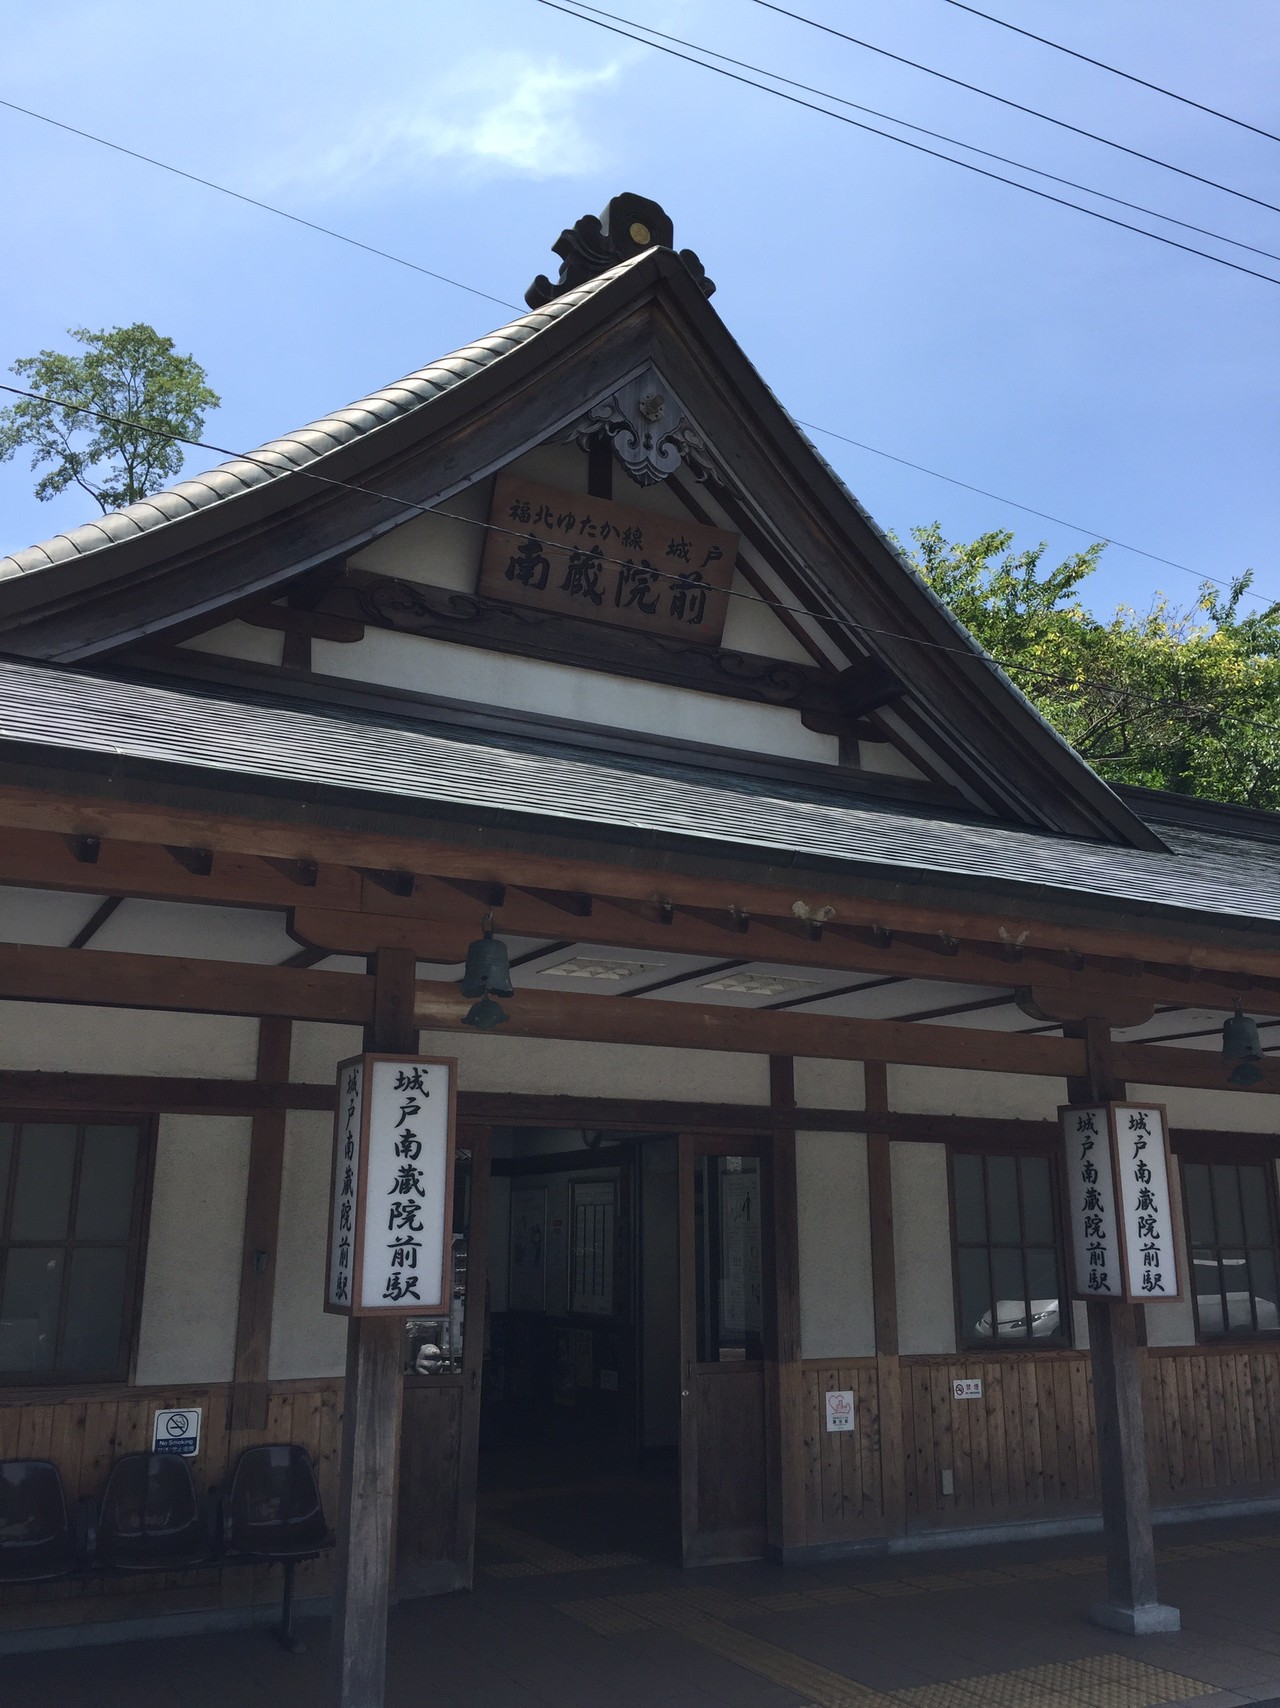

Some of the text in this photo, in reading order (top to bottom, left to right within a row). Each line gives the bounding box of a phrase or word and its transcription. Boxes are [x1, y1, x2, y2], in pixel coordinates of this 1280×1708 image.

[504, 532, 713, 624] 南蔵院前
[508, 499, 724, 568] 福北ゆたか線 城戸
[335, 1068, 359, 1301] 城戸南蔵院前駅
[382, 1066, 430, 1302] 城戸南蔵院前駅
[1076, 1112, 1111, 1292] 城戸南蔵院前駅
[1127, 1111, 1165, 1293] 城戸南蔵院前駅
